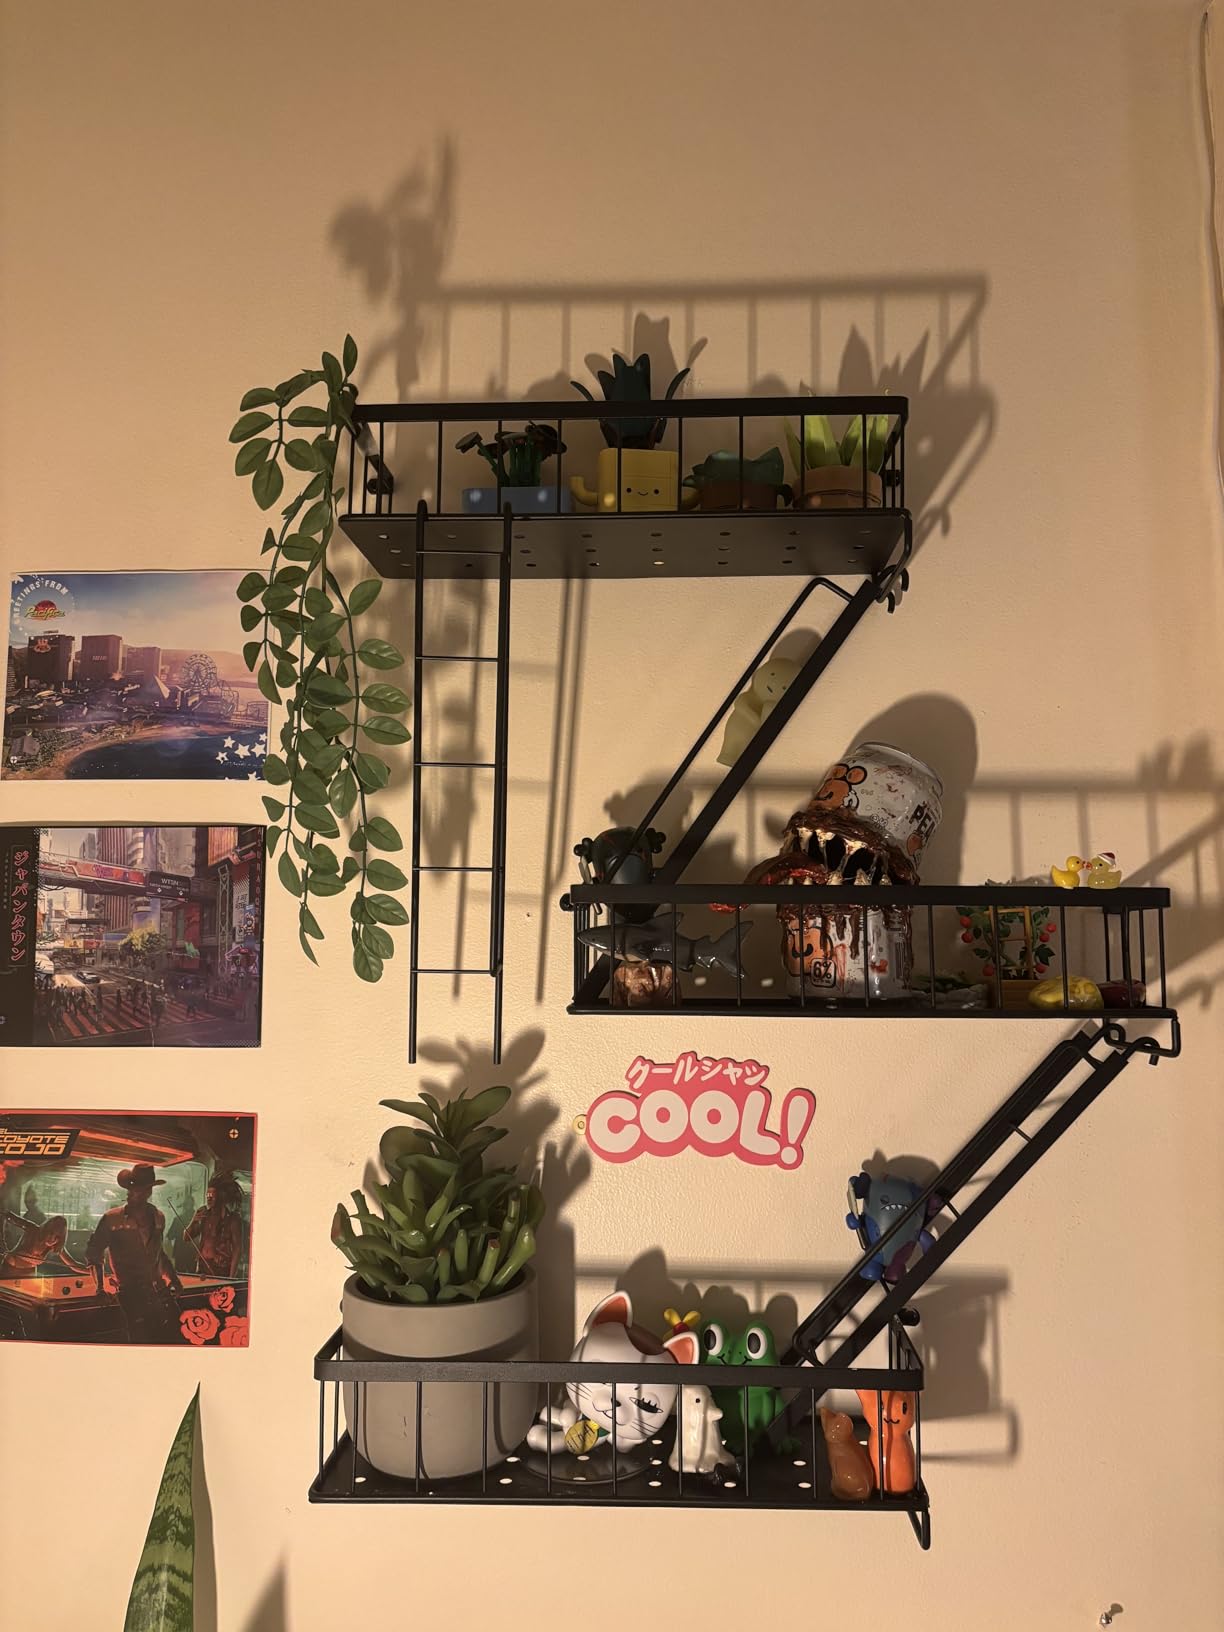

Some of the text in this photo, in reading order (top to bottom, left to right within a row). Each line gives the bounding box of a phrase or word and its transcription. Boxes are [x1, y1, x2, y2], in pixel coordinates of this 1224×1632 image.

[44, 579, 69, 595] FROM
[813, 961, 832, 979] 6%
[589, 1089, 809, 1165] COOL!
